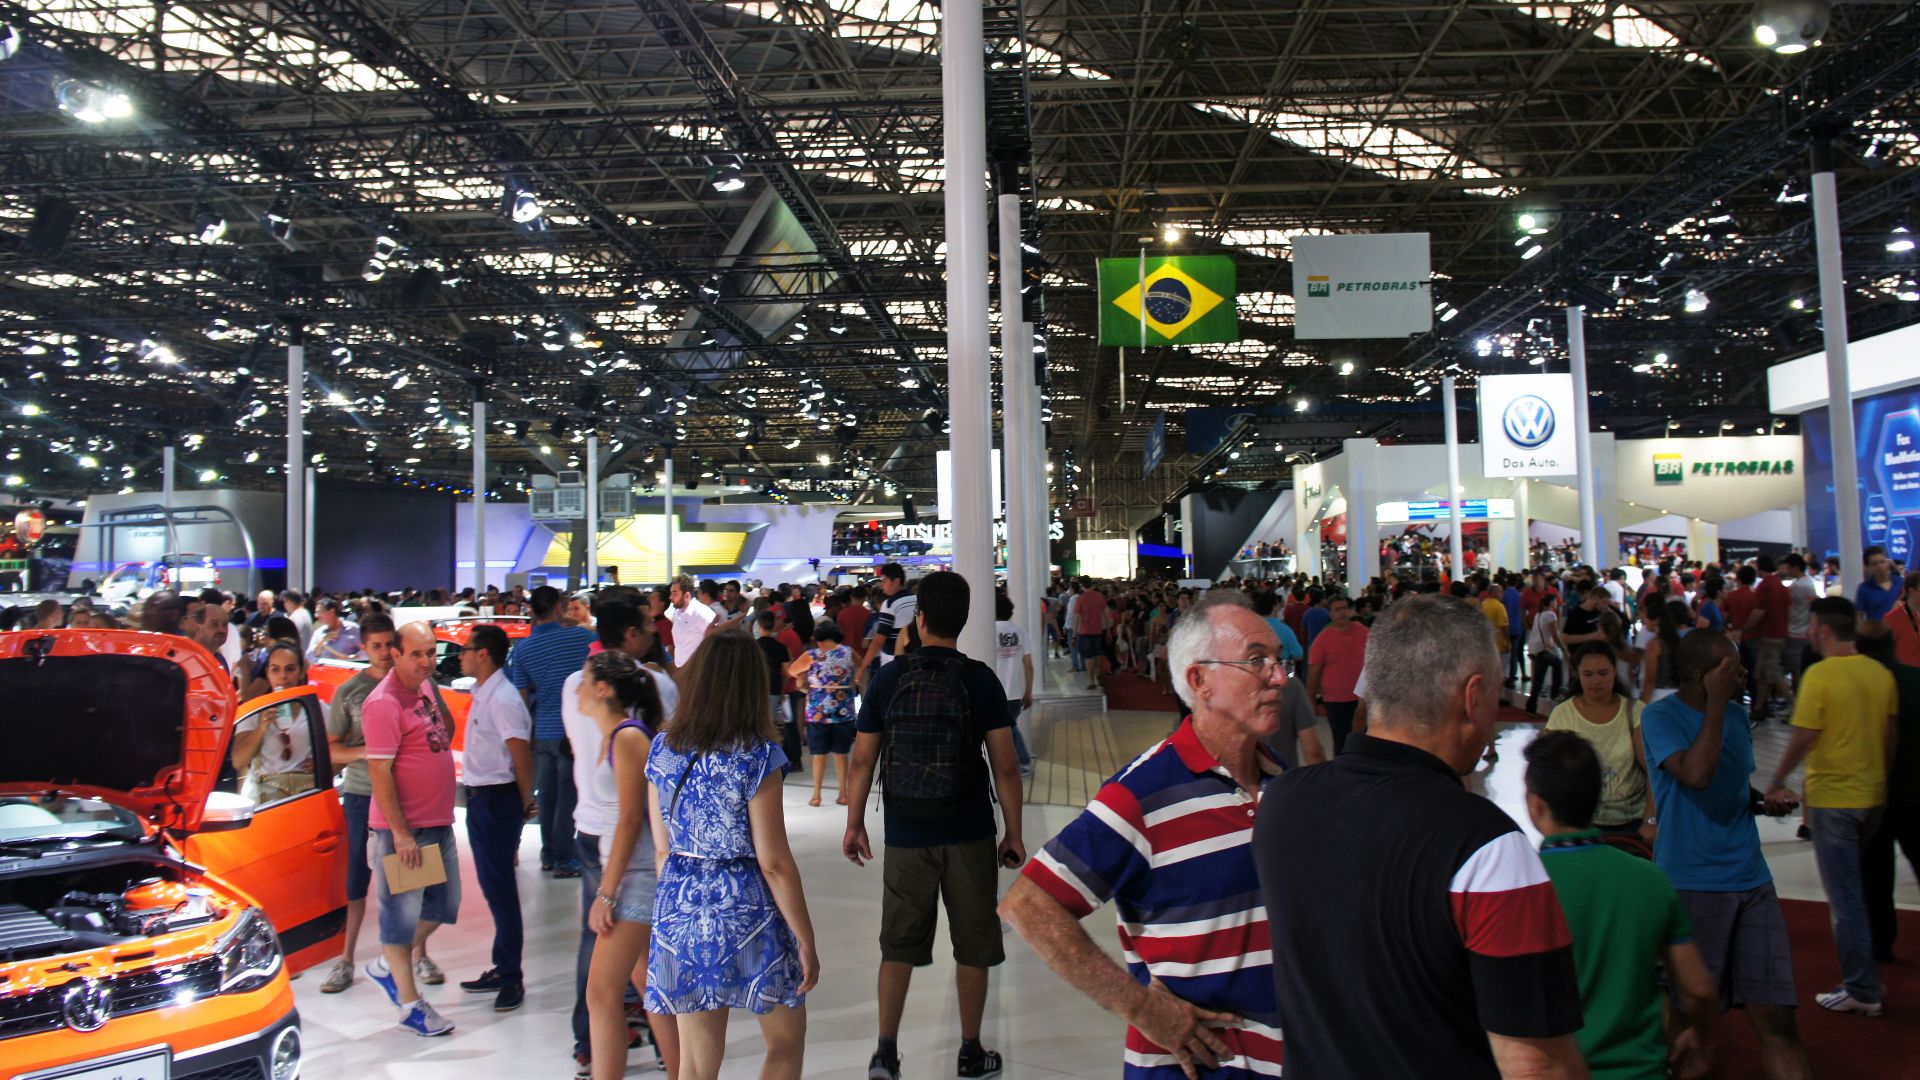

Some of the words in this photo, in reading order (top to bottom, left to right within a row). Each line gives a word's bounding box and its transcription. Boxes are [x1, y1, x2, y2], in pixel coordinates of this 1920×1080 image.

[1310, 283, 1328, 292] BR
[1337, 281, 1416, 291] PETROBRAS
[1503, 458, 1524, 468] Das
[1529, 457, 1559, 468] Auto.
[1657, 461, 1680, 475] BR
[1692, 460, 1794, 475] PETROBRAS
